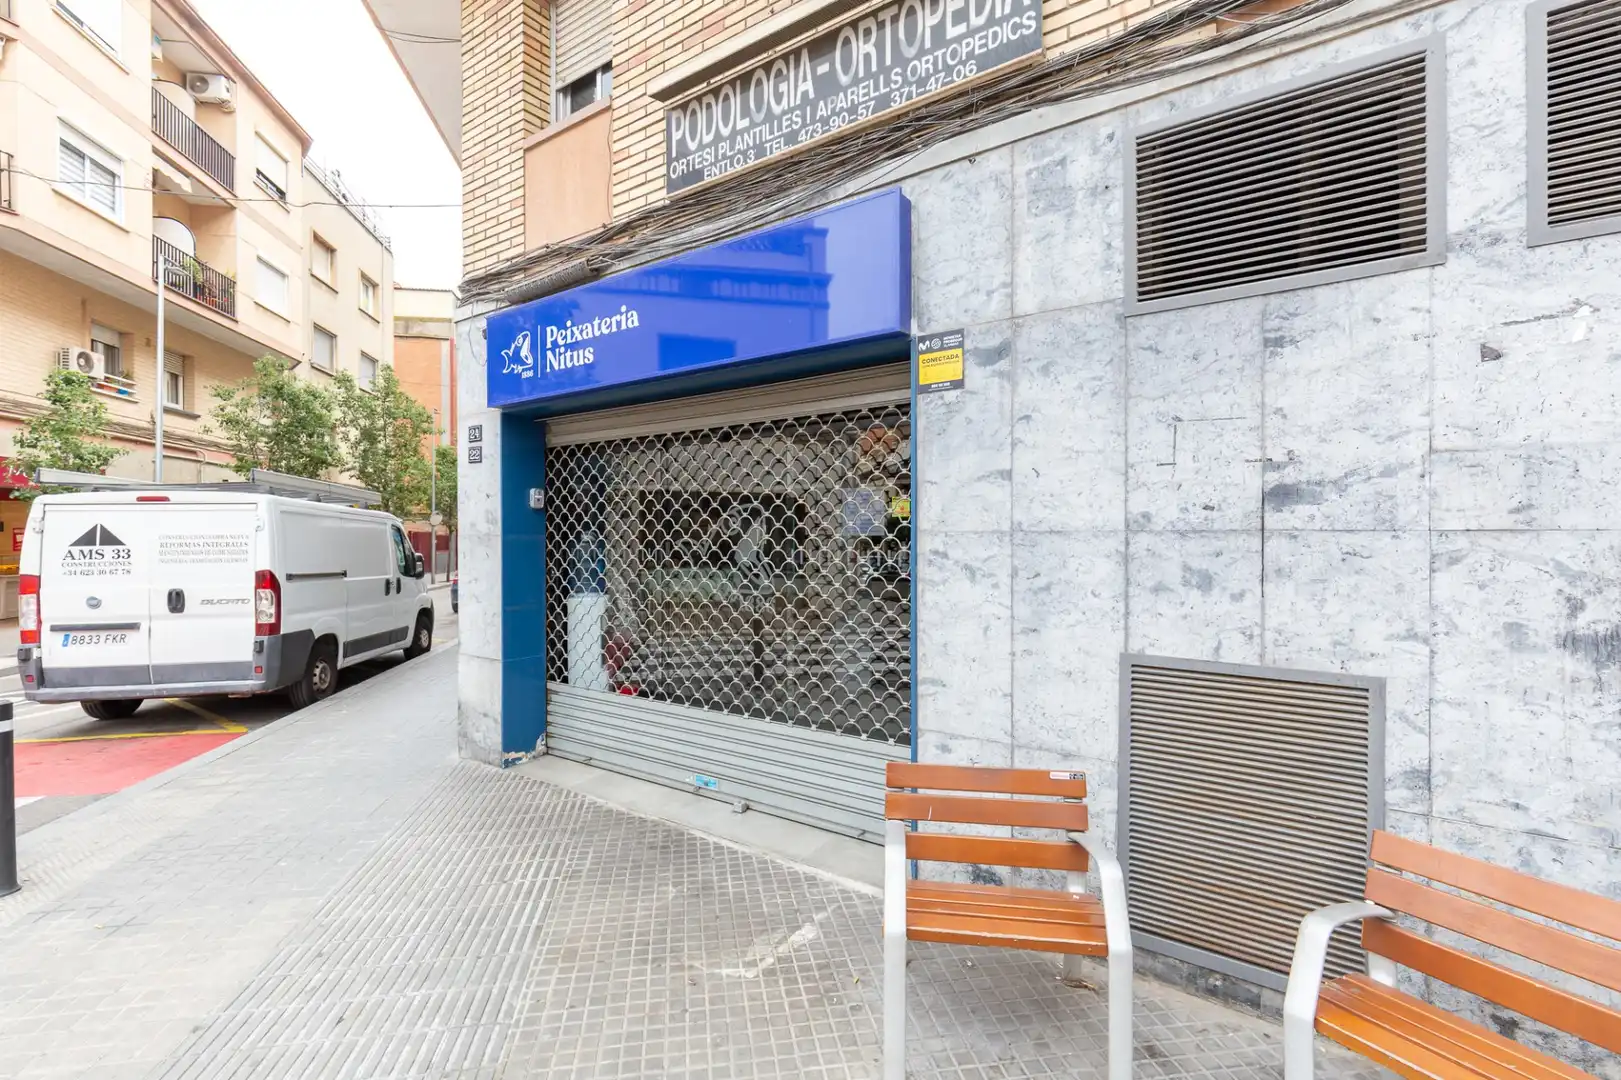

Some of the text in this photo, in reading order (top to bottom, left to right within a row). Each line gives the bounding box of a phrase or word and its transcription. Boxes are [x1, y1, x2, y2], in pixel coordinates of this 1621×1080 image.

[671, 0, 1031, 158] PODOLOGIA-ORTOPED
[718, 110, 802, 160] PLANTILLES
[806, 106, 813, 125] I
[816, 68, 902, 121] APARELLS
[907, 10, 1037, 82] ORTOPEDICS
[764, 137, 793, 157] TEL.
[797, 101, 876, 143] 473-90-57
[890, 60, 977, 107] 371-47-06
[546, 305, 640, 349] Peixateria
[546, 346, 594, 373] Nitus
[921, 353, 959, 364] CONECTADA
[469, 429, 480, 439] 24
[469, 449, 480, 460] 22
[62, 548, 131, 561] AMS 33
[61, 560, 132, 568] CONSTRUCCIONES
[200, 598, 250, 606] DUCATO
[71, 633, 127, 645] 8833 FKR
